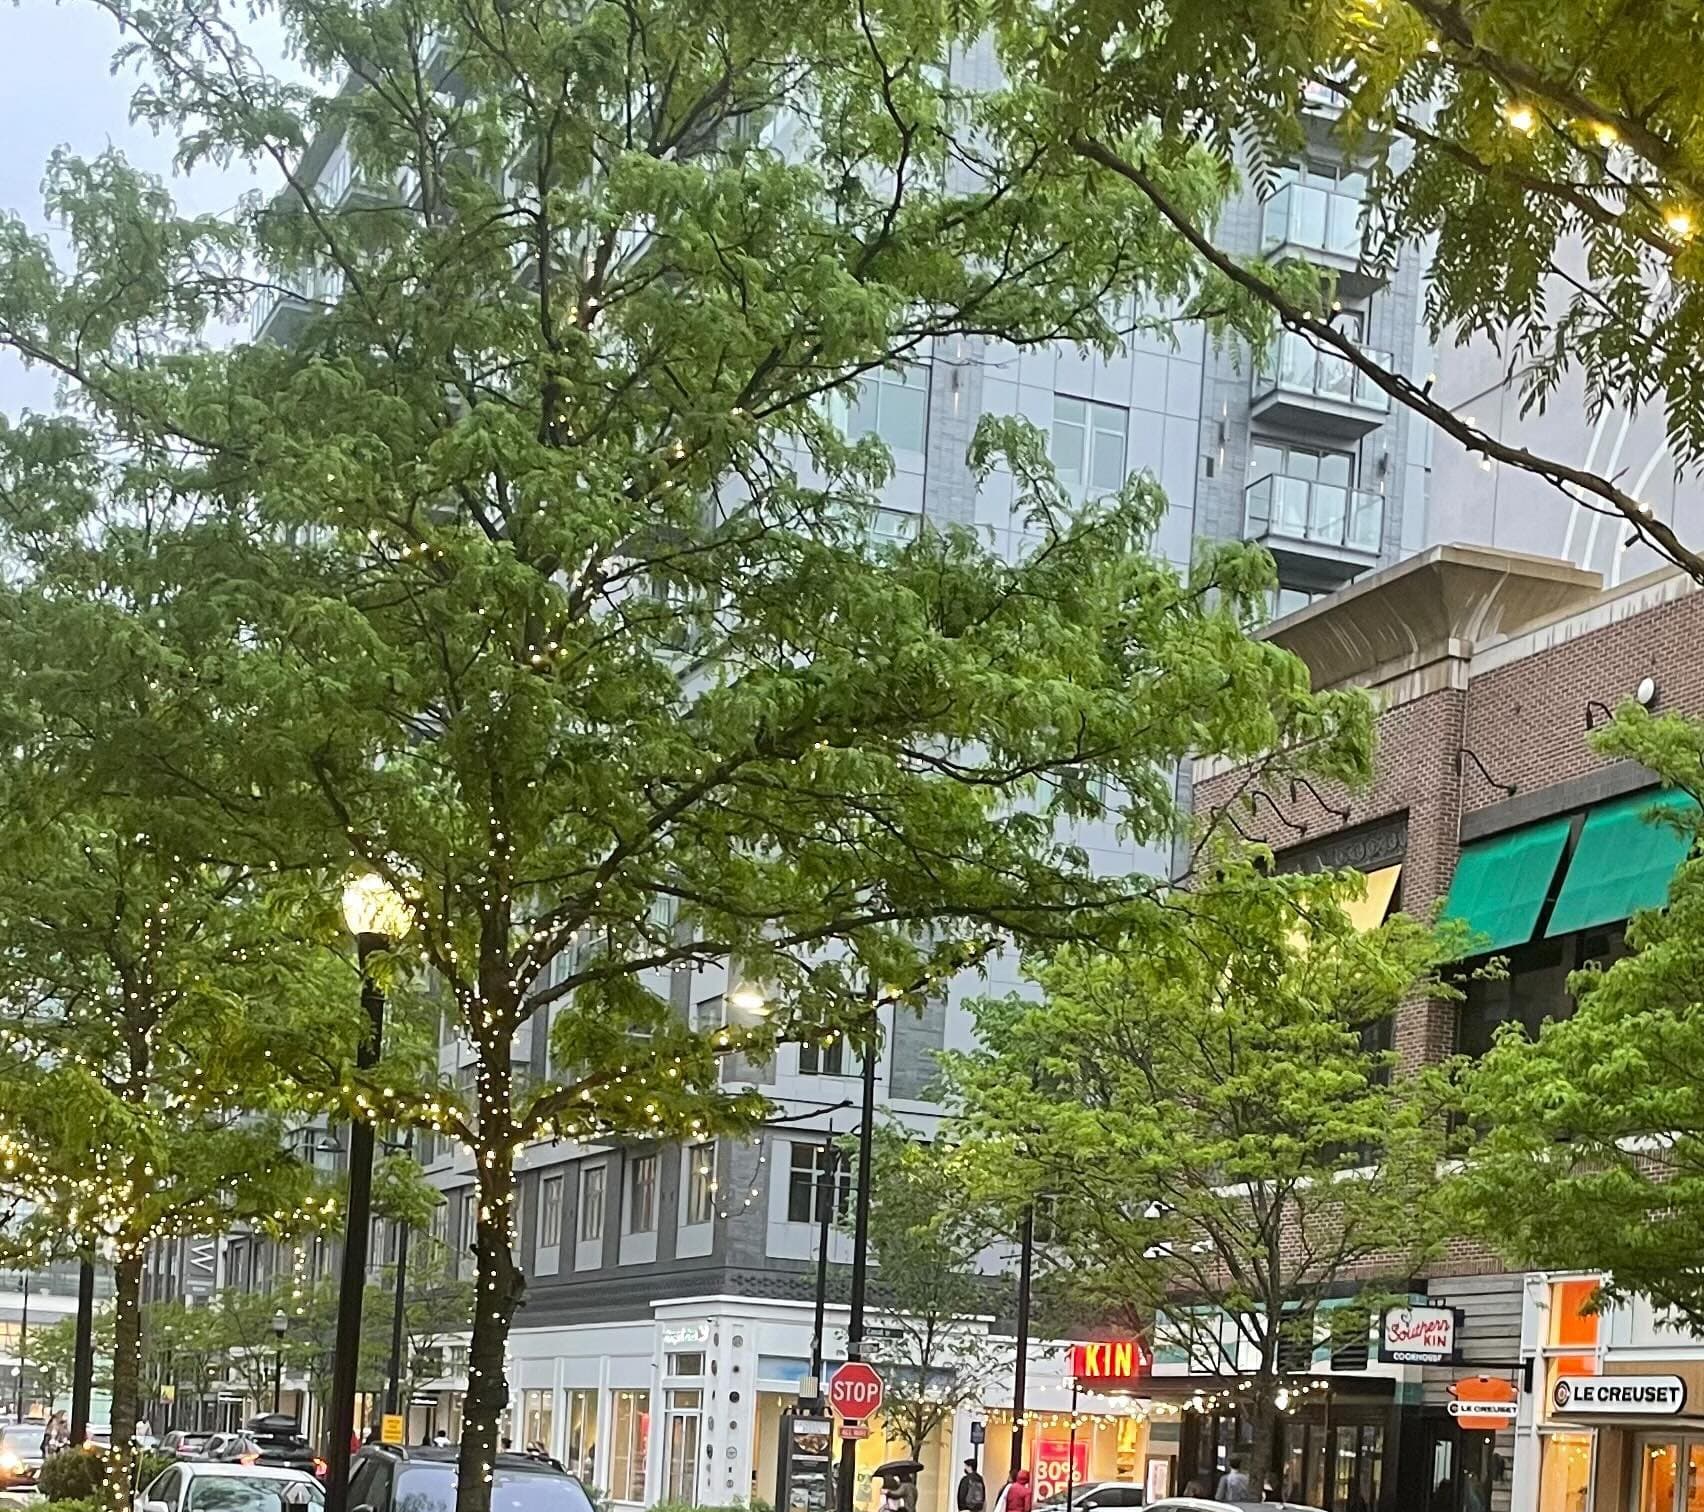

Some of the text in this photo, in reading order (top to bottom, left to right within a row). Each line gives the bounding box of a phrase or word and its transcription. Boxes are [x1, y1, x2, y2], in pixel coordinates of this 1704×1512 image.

[1388, 1320, 1450, 1342] Southern
[1424, 1335, 1447, 1347] KIN
[1085, 1343, 1132, 1377] KIN
[834, 1381, 879, 1402] STOP
[1573, 1386, 1680, 1402] LE CREUSET
[1474, 1405, 1517, 1413] CREUSET
[1037, 1461, 1082, 1482] 30%
